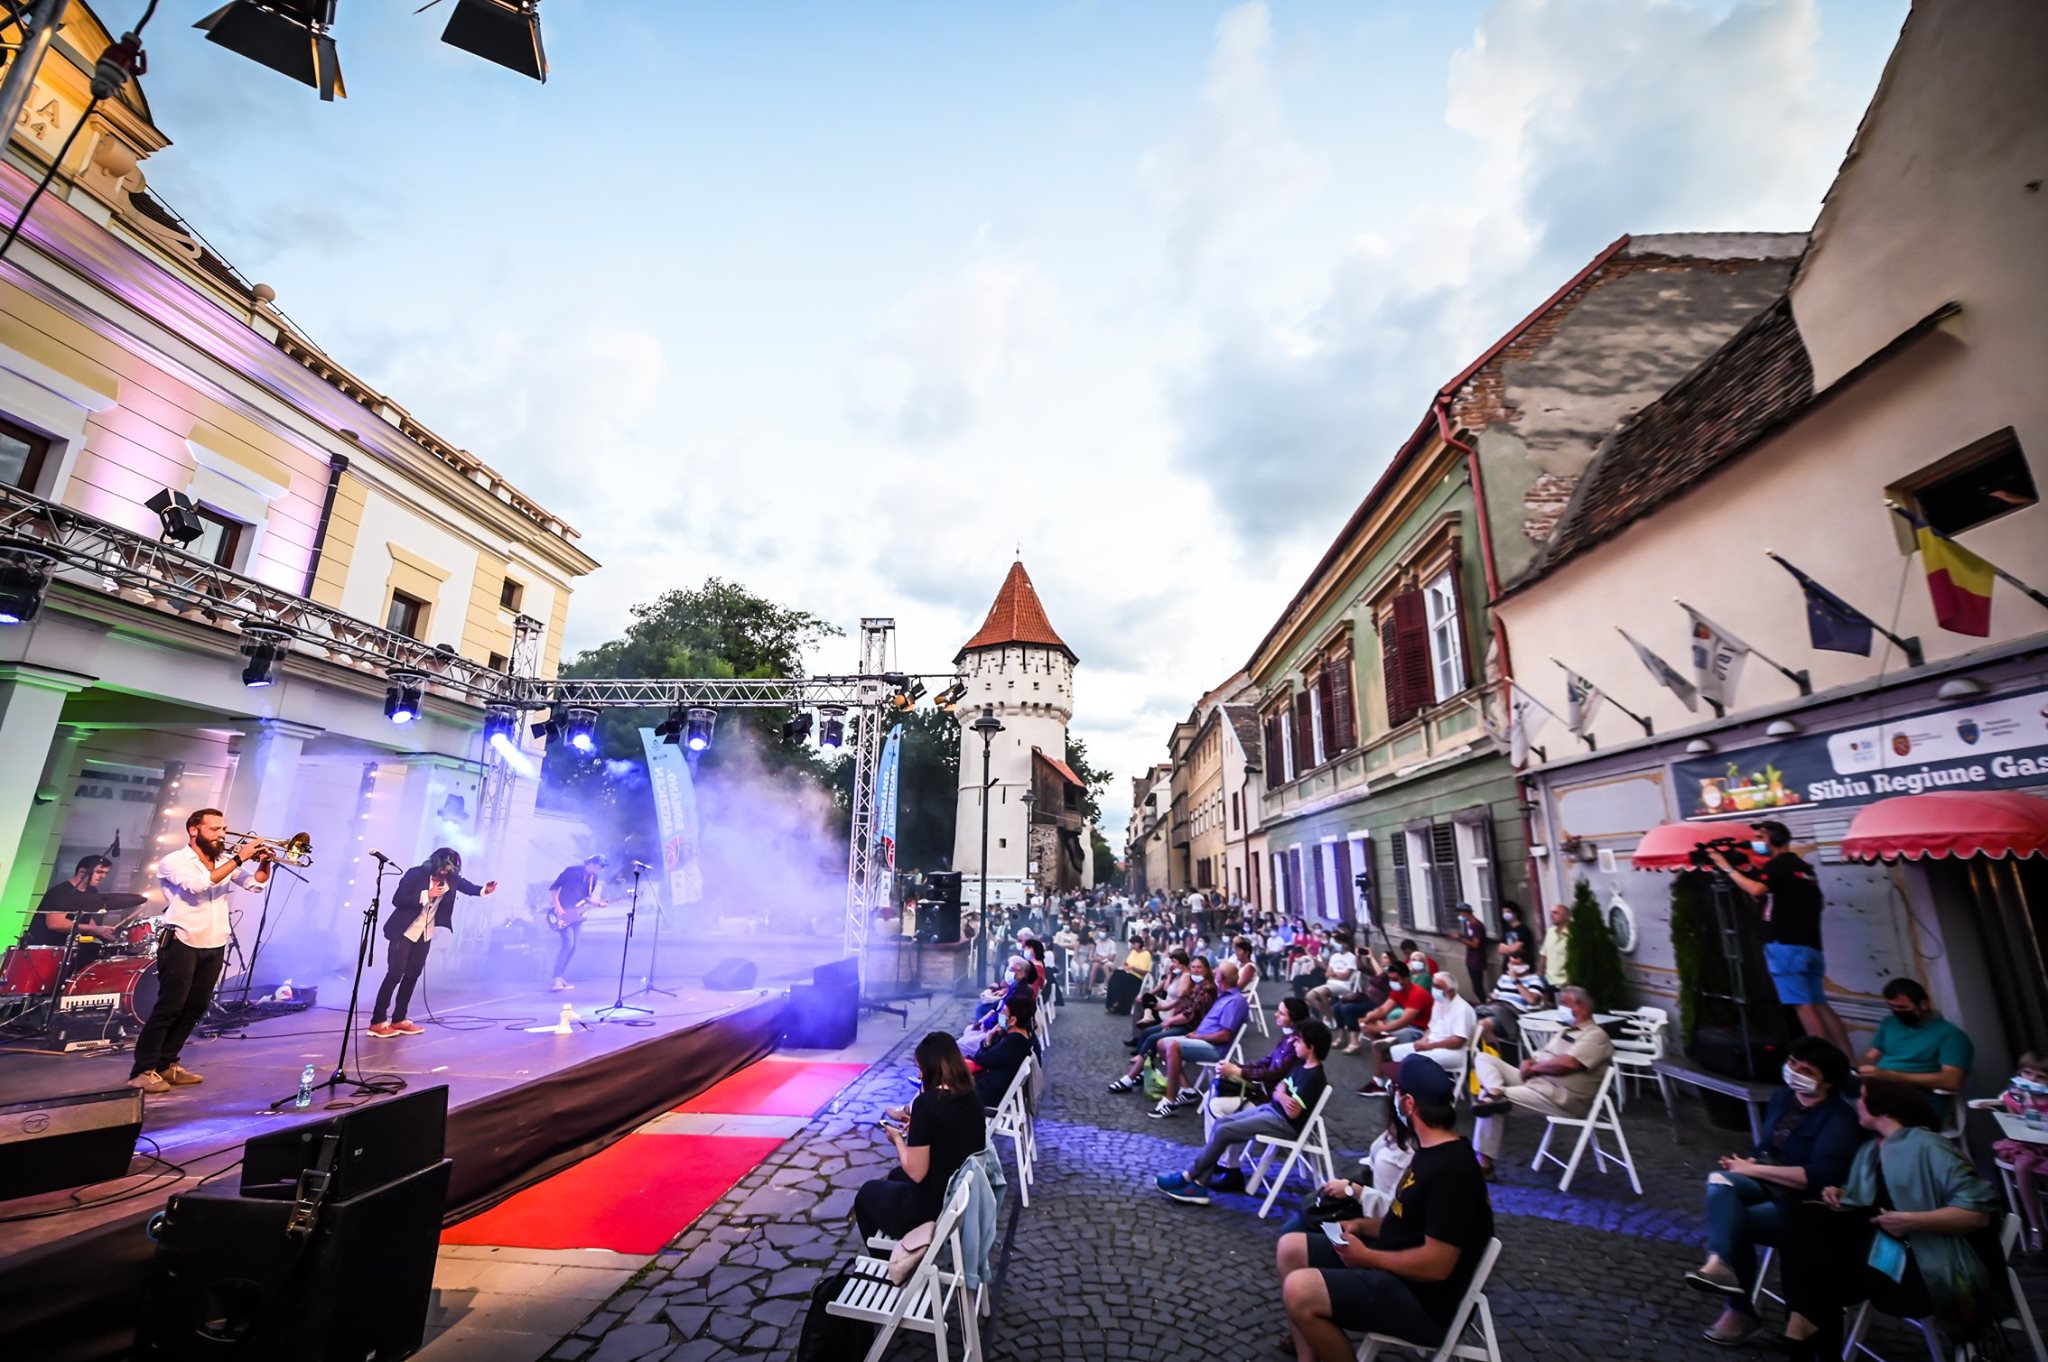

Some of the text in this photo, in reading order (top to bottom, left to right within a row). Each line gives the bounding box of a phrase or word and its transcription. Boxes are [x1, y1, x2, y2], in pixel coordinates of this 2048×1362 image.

[887, 763, 897, 834] AMERICAN
[1808, 777, 1870, 801] Sibiu
[1871, 766, 1987, 794] Regiune
